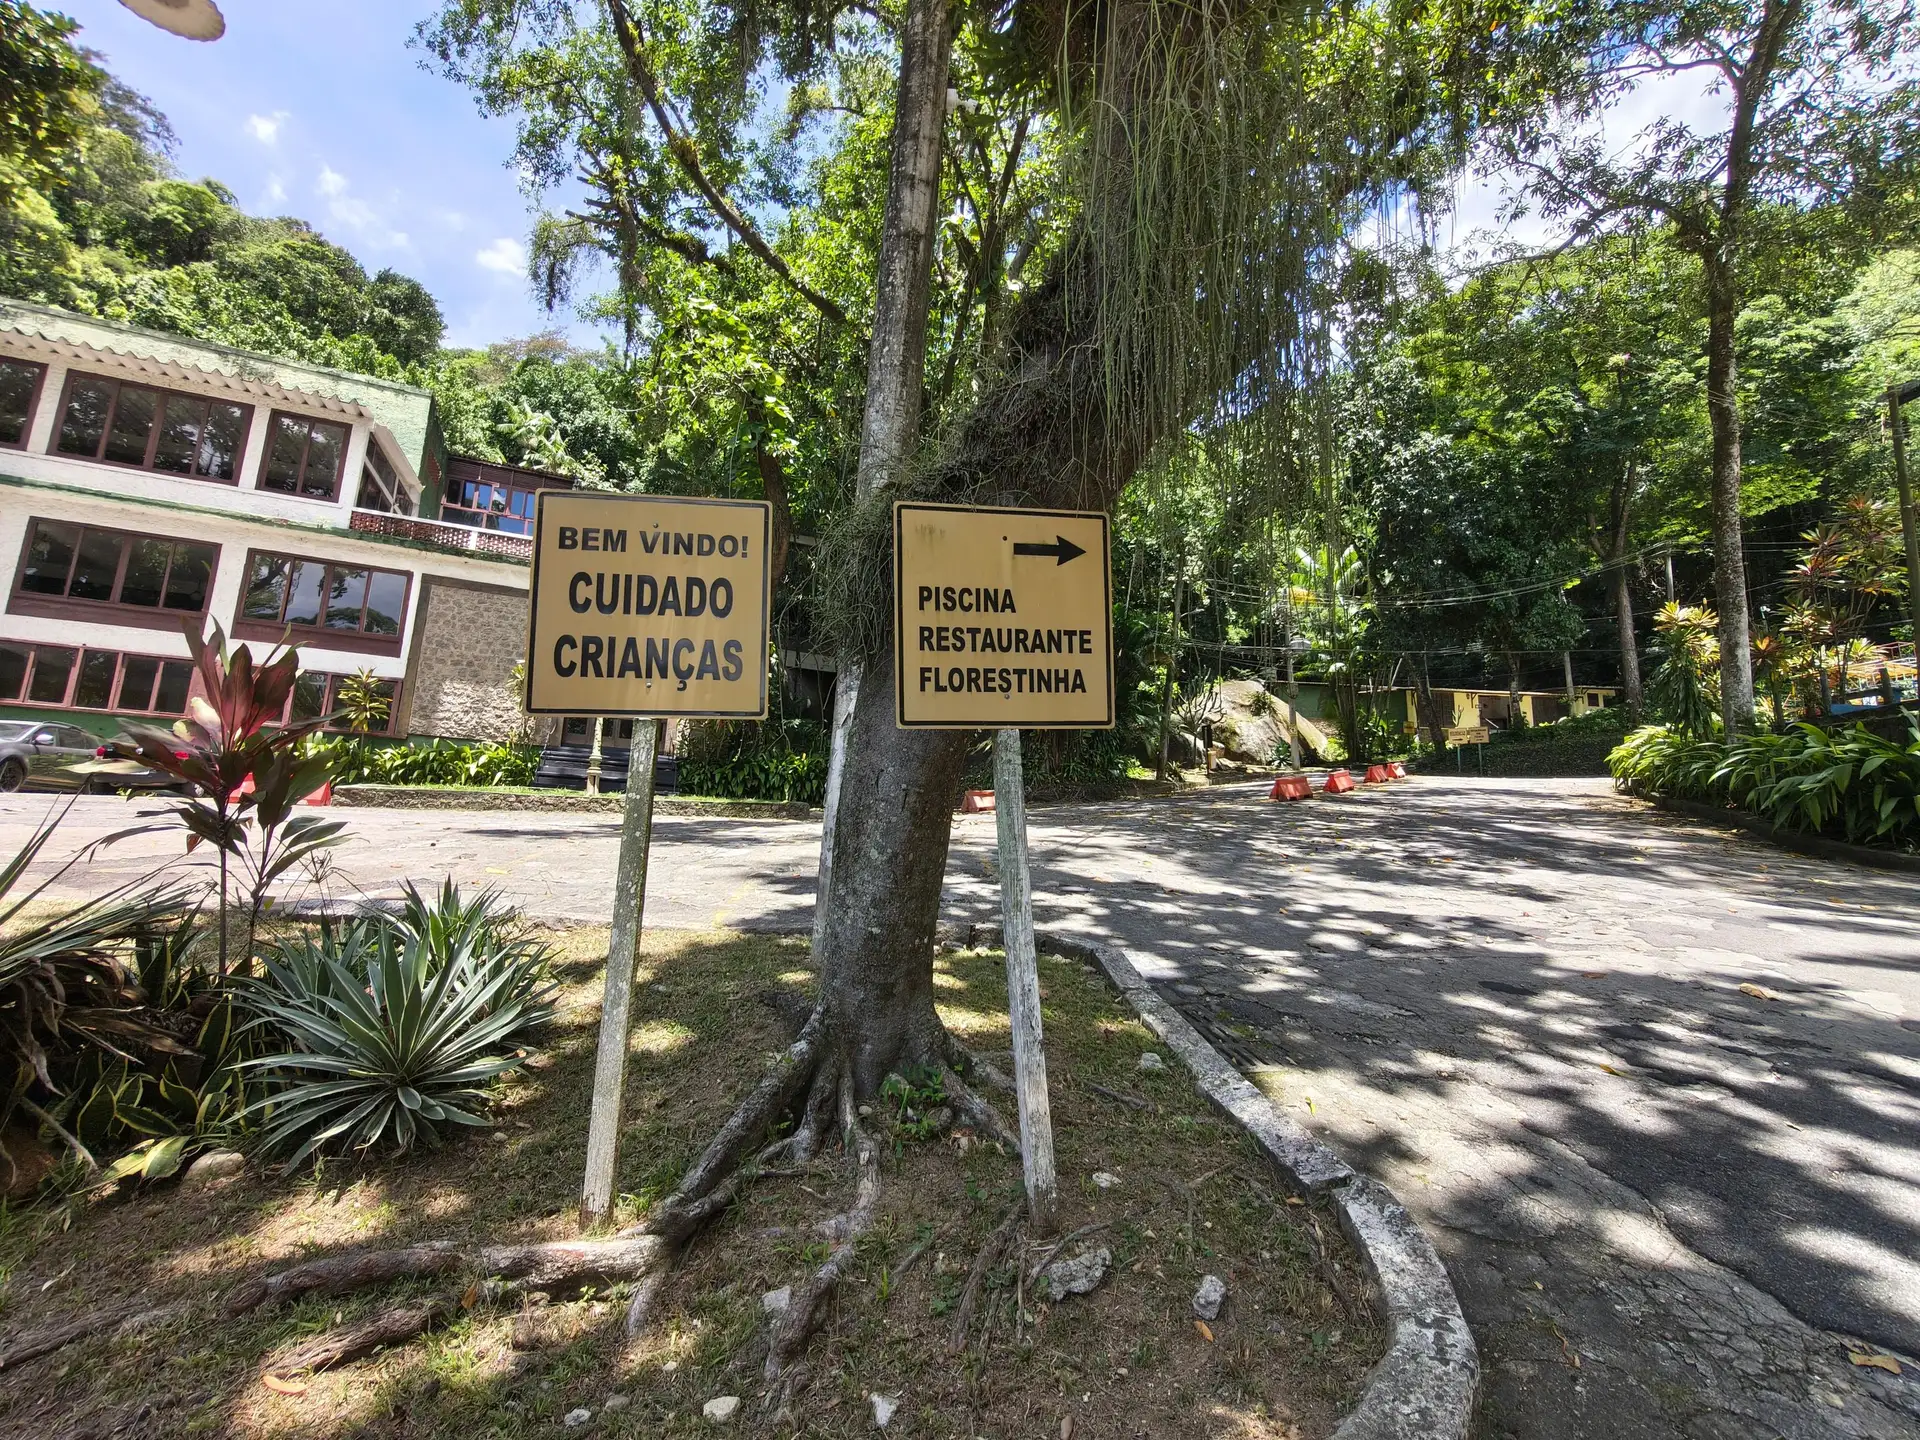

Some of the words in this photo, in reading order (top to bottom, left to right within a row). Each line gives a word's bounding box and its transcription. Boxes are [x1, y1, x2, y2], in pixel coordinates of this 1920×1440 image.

[558, 526, 627, 553] BEM
[639, 530, 749, 558] VINDO!
[569, 571, 734, 619] CUIDADO
[918, 586, 1017, 613] PISCINA
[919, 626, 1093, 654] RESTAURANTE
[553, 634, 743, 692] CRIANÇAS
[919, 667, 1087, 693] FLORESTINHA
